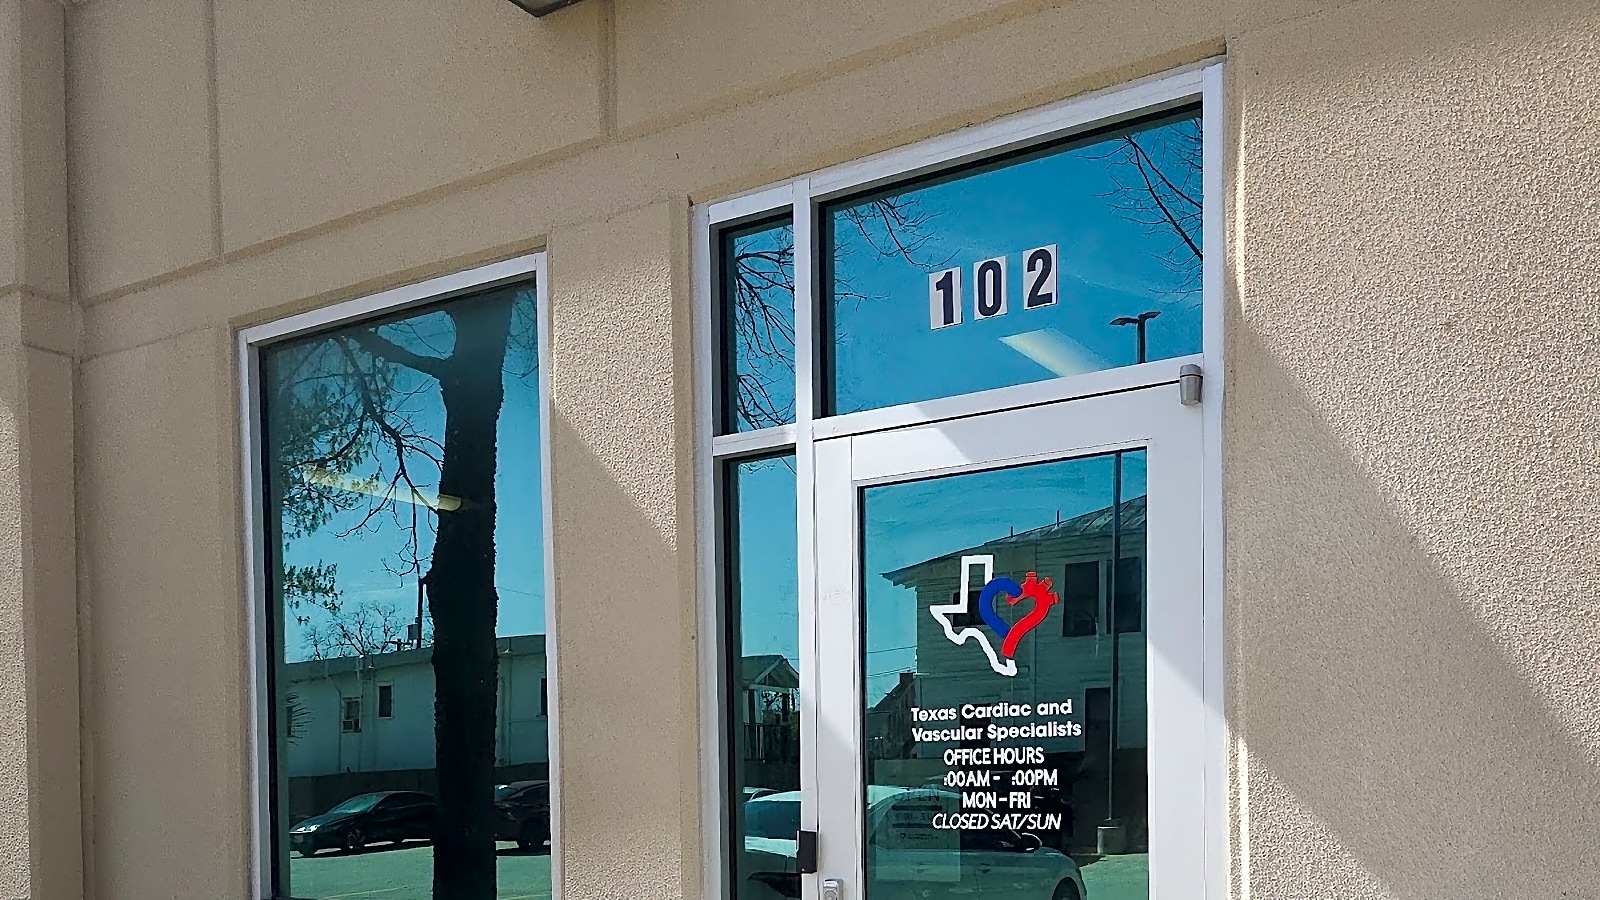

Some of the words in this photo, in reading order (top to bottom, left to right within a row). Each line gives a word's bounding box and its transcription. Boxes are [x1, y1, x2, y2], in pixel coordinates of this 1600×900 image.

[910, 707, 957, 722] Texas
[961, 702, 1032, 719] Cardiac
[1036, 698, 1073, 716] and
[911, 725, 984, 742] Vascular
[986, 720, 1082, 742] Specialists
[943, 748, 992, 766] OFFICE
[994, 746, 1046, 765] HOURS
[962, 791, 997, 809] MON
[1009, 791, 1031, 809] FRI
[932, 813, 990, 830] CLOSED
[990, 813, 1062, 830] SAT/SUN
